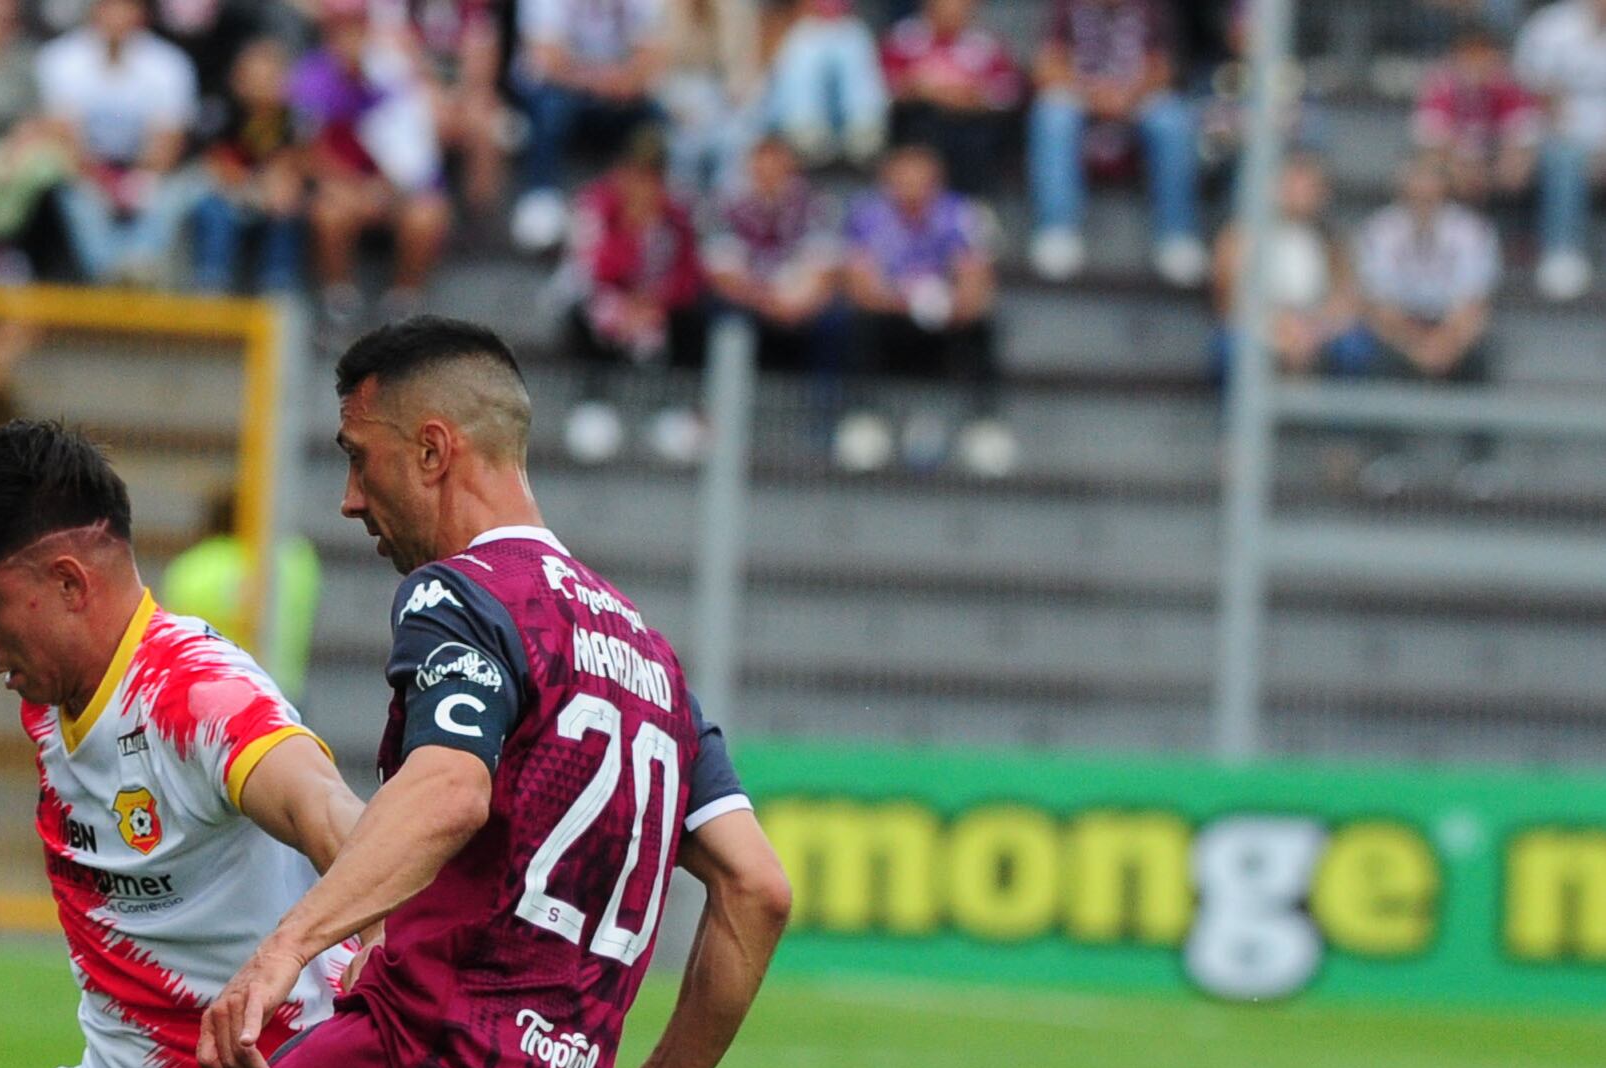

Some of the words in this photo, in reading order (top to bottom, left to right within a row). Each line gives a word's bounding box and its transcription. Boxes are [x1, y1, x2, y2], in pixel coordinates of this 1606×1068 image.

[434, 693, 487, 737] C
[573, 623, 672, 713] MARIANO
[514, 692, 679, 967] 20
[762, 796, 1441, 1000] monge
